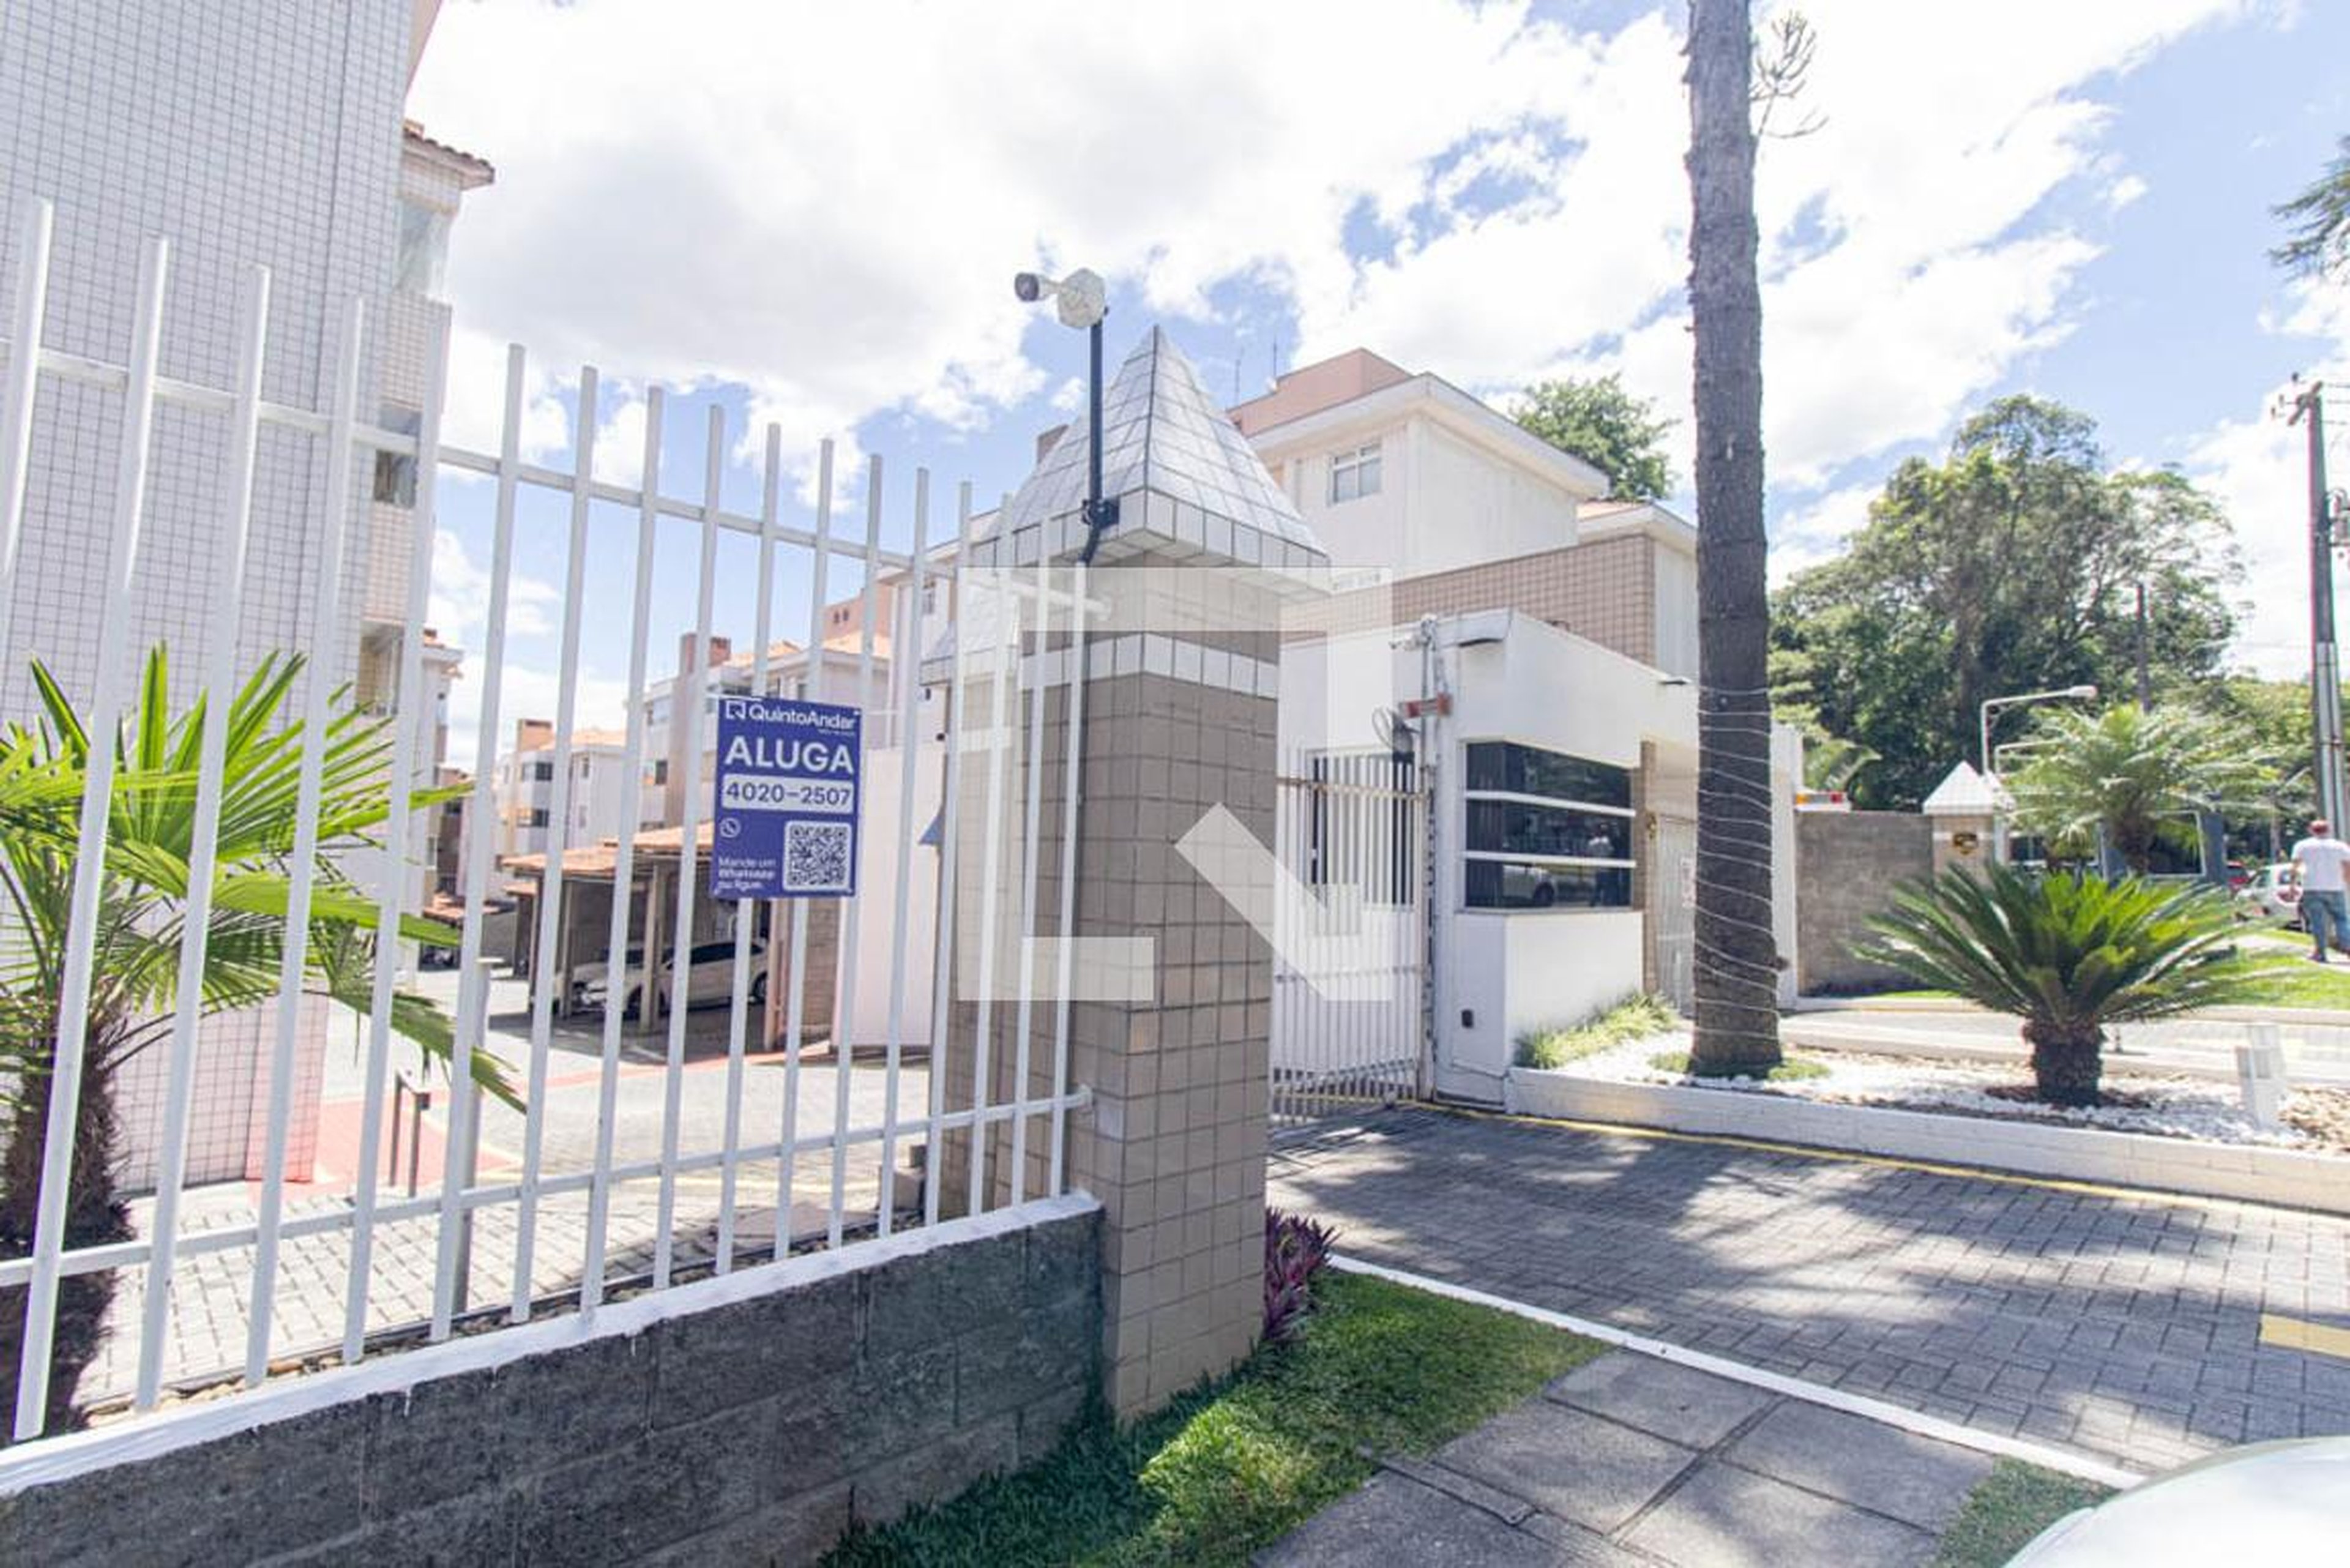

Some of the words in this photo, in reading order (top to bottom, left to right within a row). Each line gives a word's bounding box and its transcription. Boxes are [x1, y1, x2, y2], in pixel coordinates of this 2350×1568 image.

[749, 704, 855, 730] QuintoAndar
[725, 736, 854, 774] ALUGA
[726, 782, 851, 805] 4020-2507
